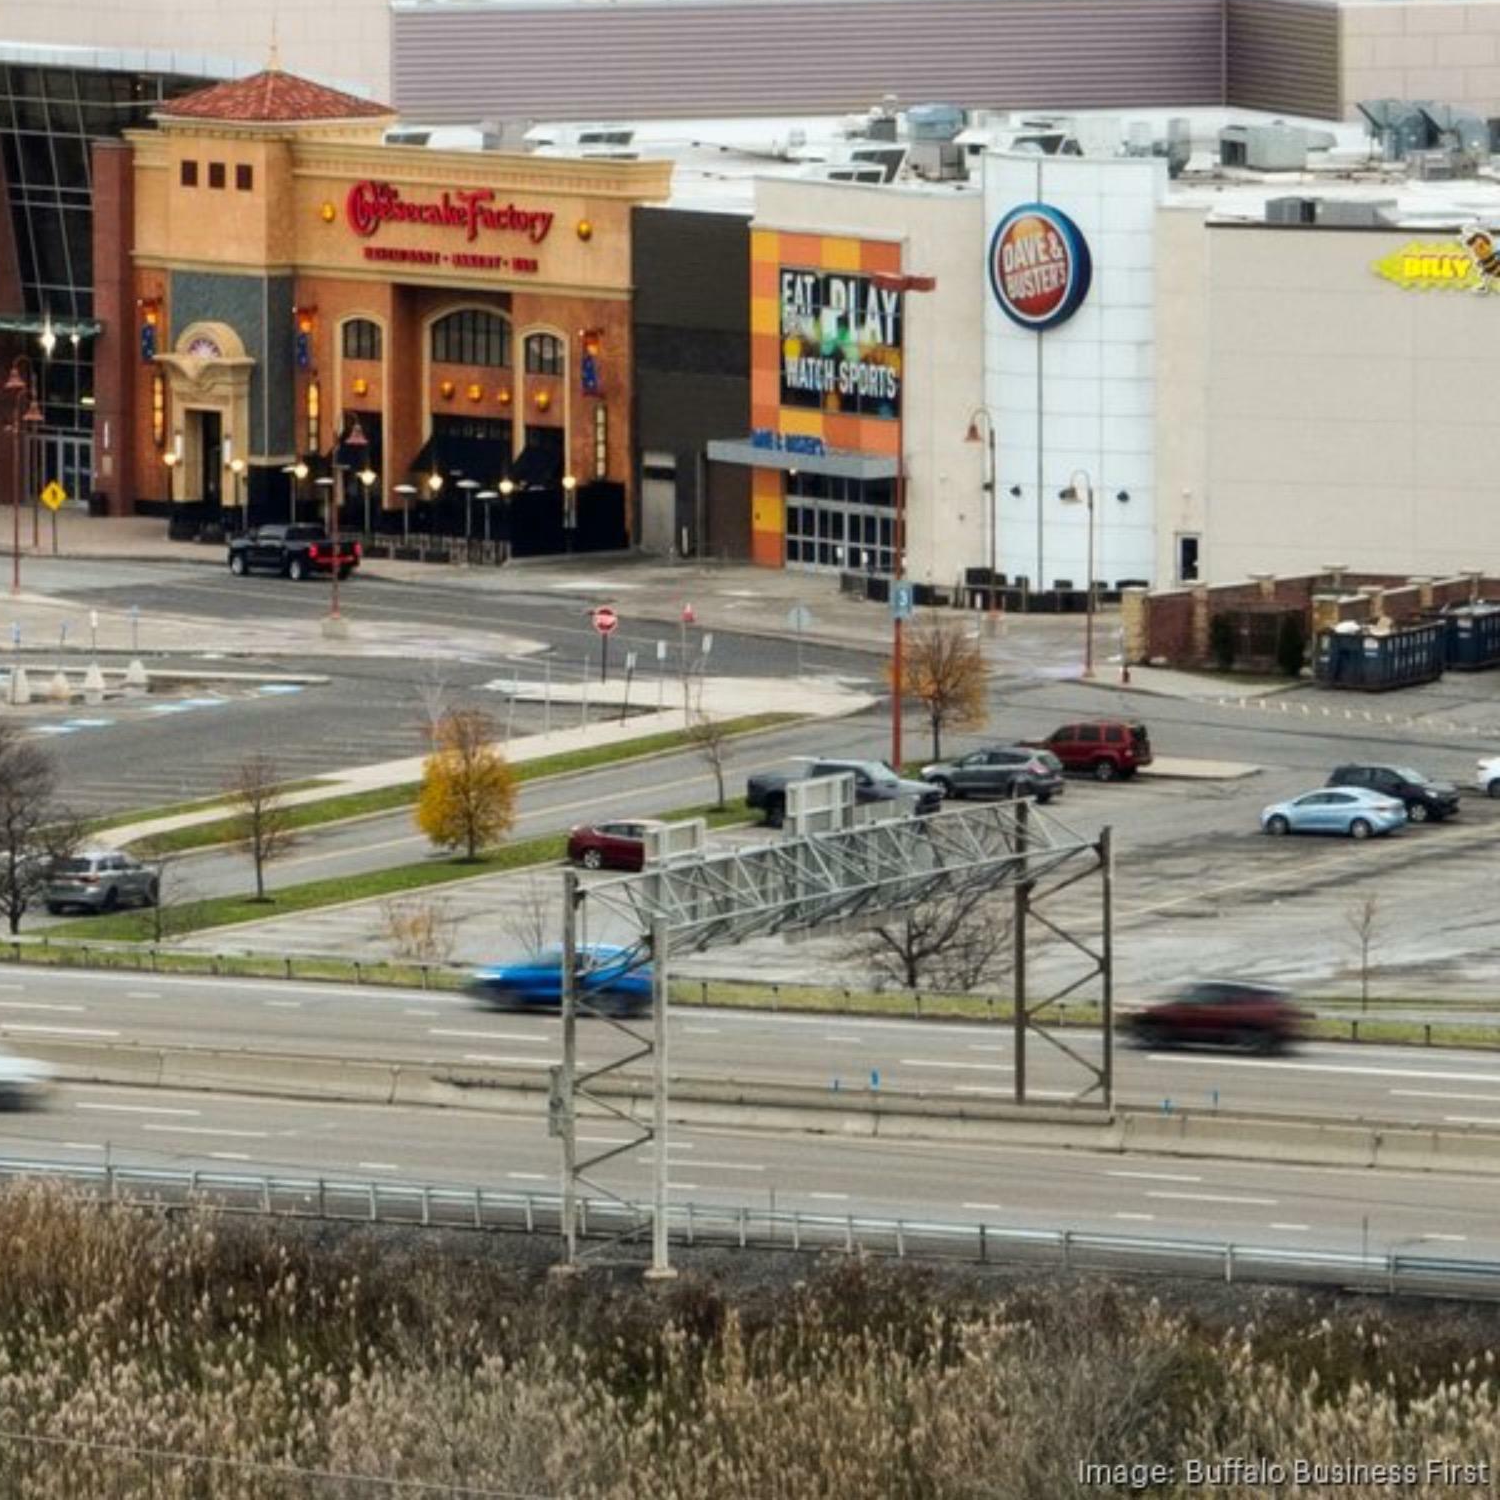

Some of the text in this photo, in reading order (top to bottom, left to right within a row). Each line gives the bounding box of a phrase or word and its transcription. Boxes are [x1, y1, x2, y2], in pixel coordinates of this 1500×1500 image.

[456, 187, 554, 245] Factory
[1003, 238, 1050, 273] DAVE
[1403, 254, 1470, 278] BILLY
[782, 273, 815, 316] EAT
[829, 279, 898, 345] PLAY
[784, 357, 897, 399] WATCH SPORTS
